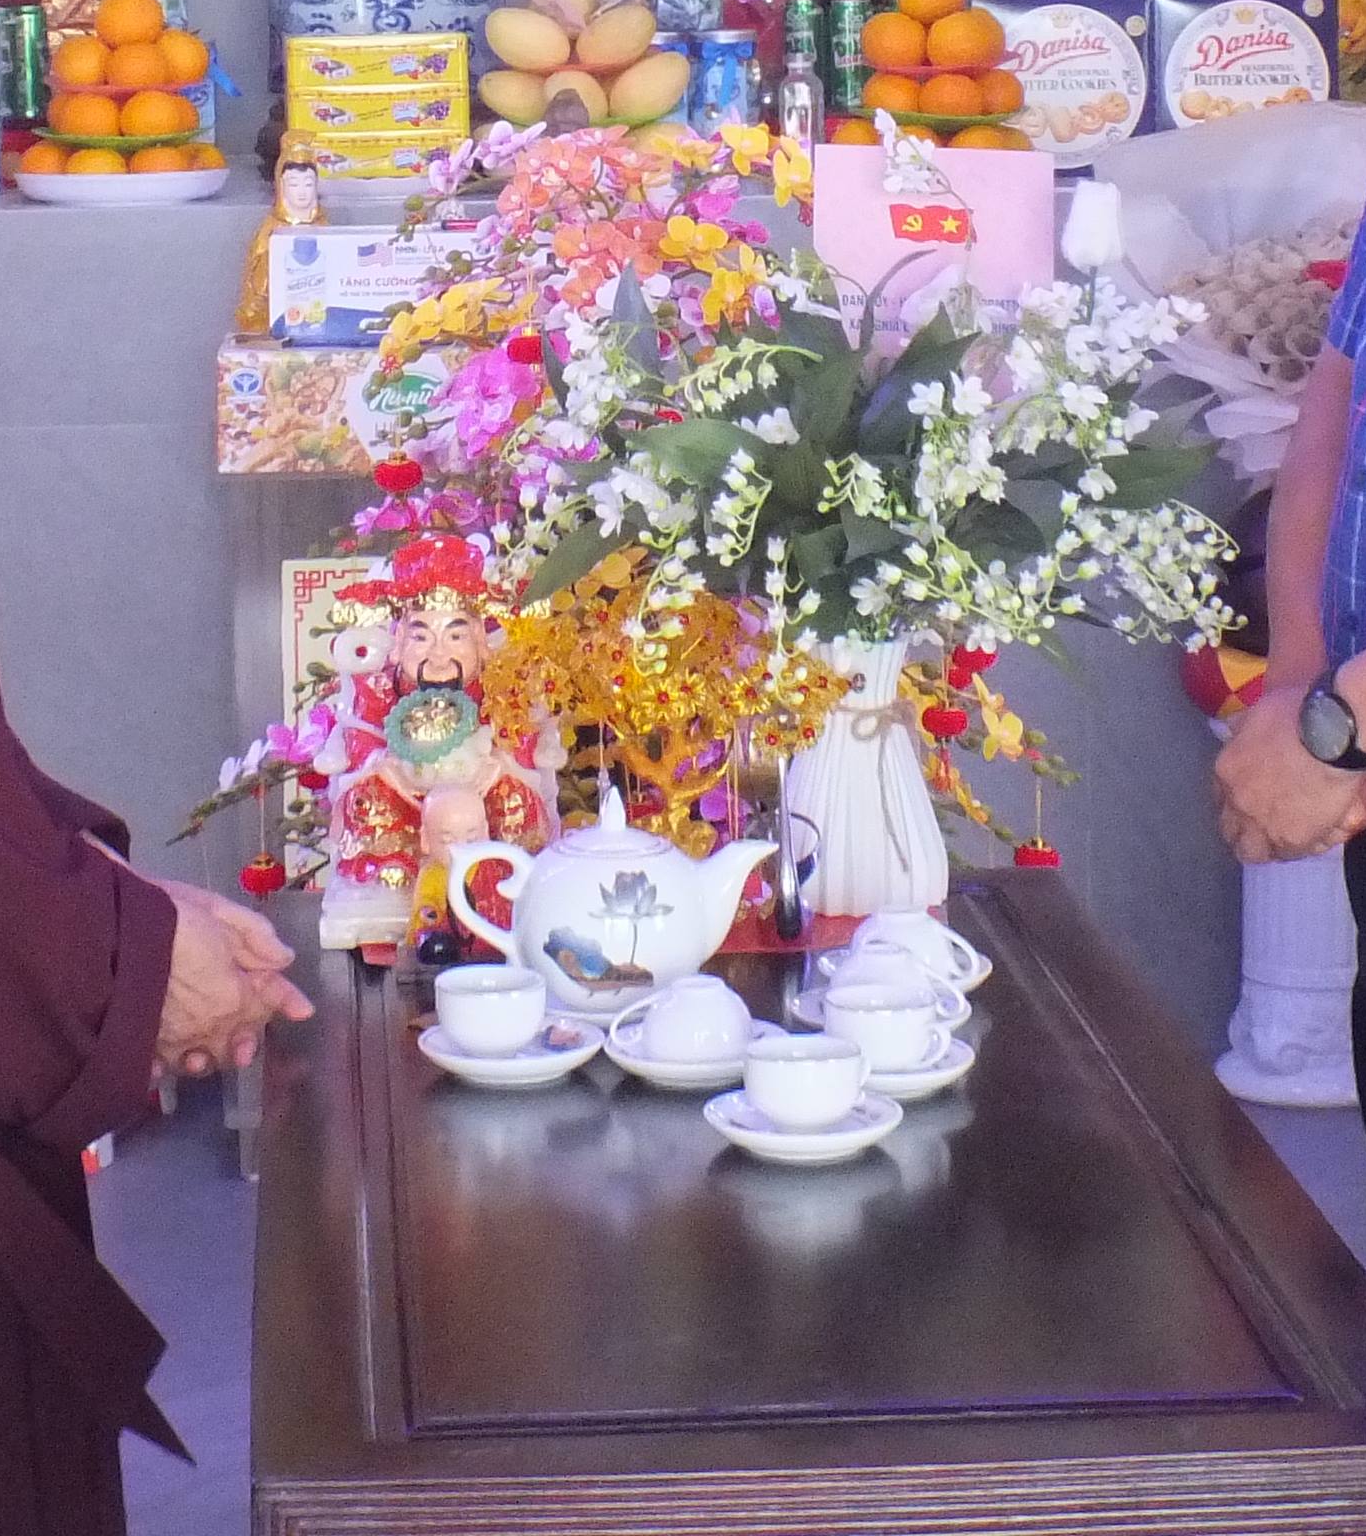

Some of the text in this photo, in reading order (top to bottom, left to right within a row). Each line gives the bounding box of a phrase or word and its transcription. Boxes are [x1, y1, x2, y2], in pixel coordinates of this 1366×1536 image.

[1012, 28, 1111, 75] Danisa
[1189, 24, 1295, 71] Danisa
[1023, 78, 1118, 91] TTER COOKIES
[1194, 72, 1302, 86] BUTTER COOKIES
